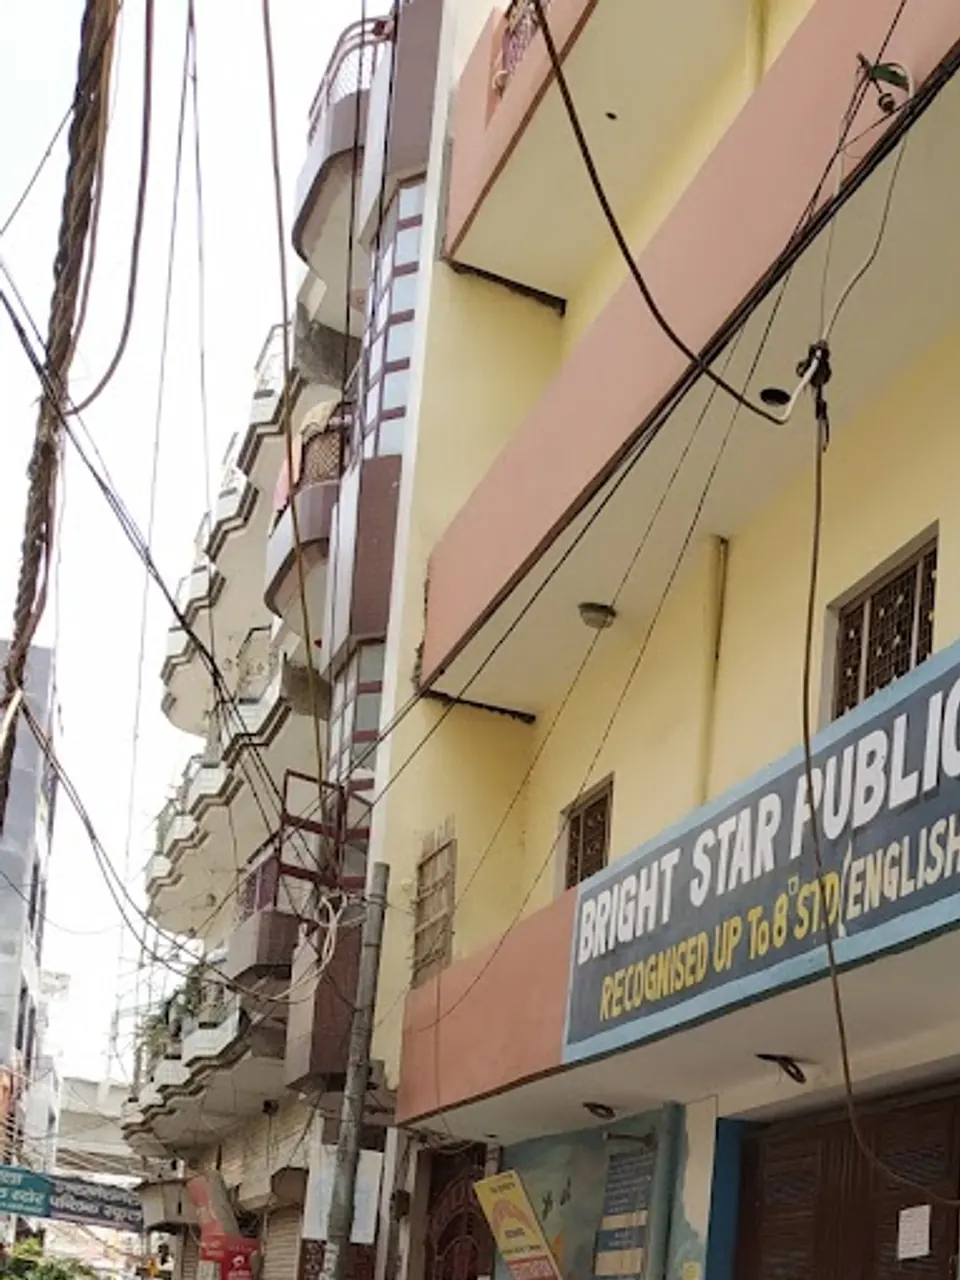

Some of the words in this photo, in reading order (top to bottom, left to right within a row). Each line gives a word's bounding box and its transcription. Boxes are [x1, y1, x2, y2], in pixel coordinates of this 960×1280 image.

[577, 846, 680, 965] BRIGHT
[689, 792, 782, 908] STAR
[600, 931, 709, 1022] RECOGNISED
[712, 915, 743, 973] UP
